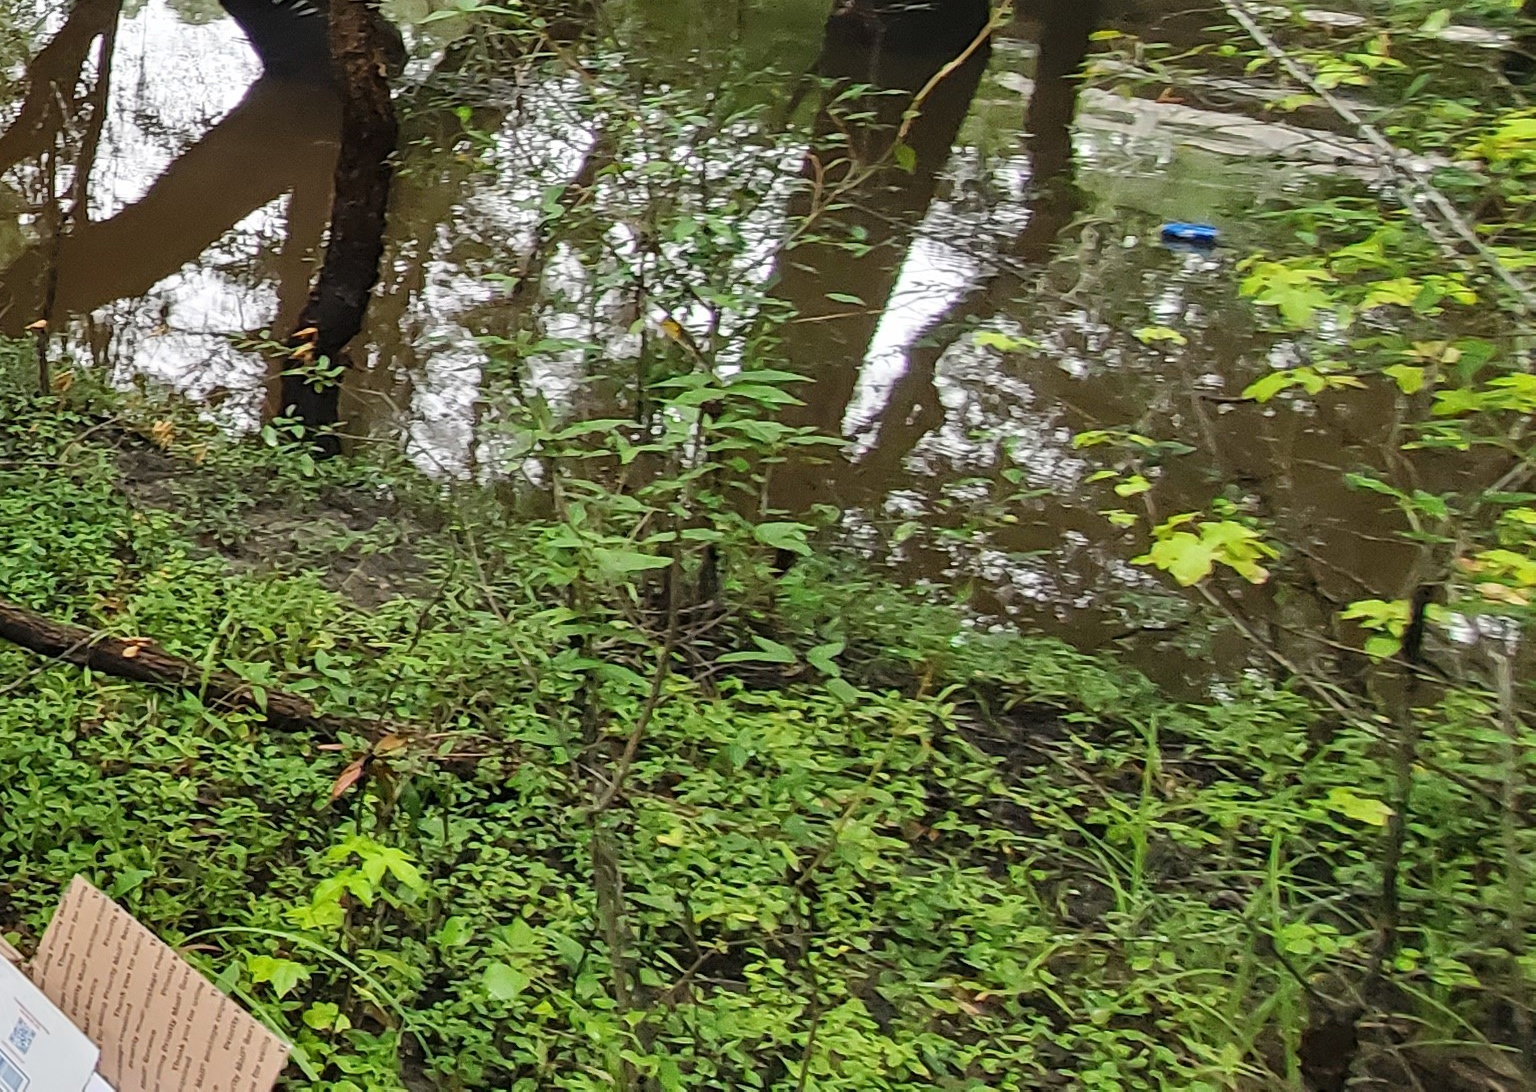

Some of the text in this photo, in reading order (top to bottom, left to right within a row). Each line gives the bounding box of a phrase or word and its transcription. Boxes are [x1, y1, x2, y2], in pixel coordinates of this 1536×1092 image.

[57, 941, 69, 967] Thank
[67, 924, 75, 940] you
[71, 910, 79, 923] for
[101, 914, 118, 947] Priority
[126, 956, 135, 970] for
[102, 966, 117, 1000] Priority
[122, 971, 131, 988] you
[159, 961, 176, 997] Priority
[112, 990, 125, 1017] Thank
[185, 1008, 195, 1022] for
[160, 1018, 177, 1053] Priority
[181, 1023, 191, 1042] you
[222, 1015, 238, 1051] Priority
[171, 1042, 185, 1071] Thank
[250, 1063, 262, 1078] for
